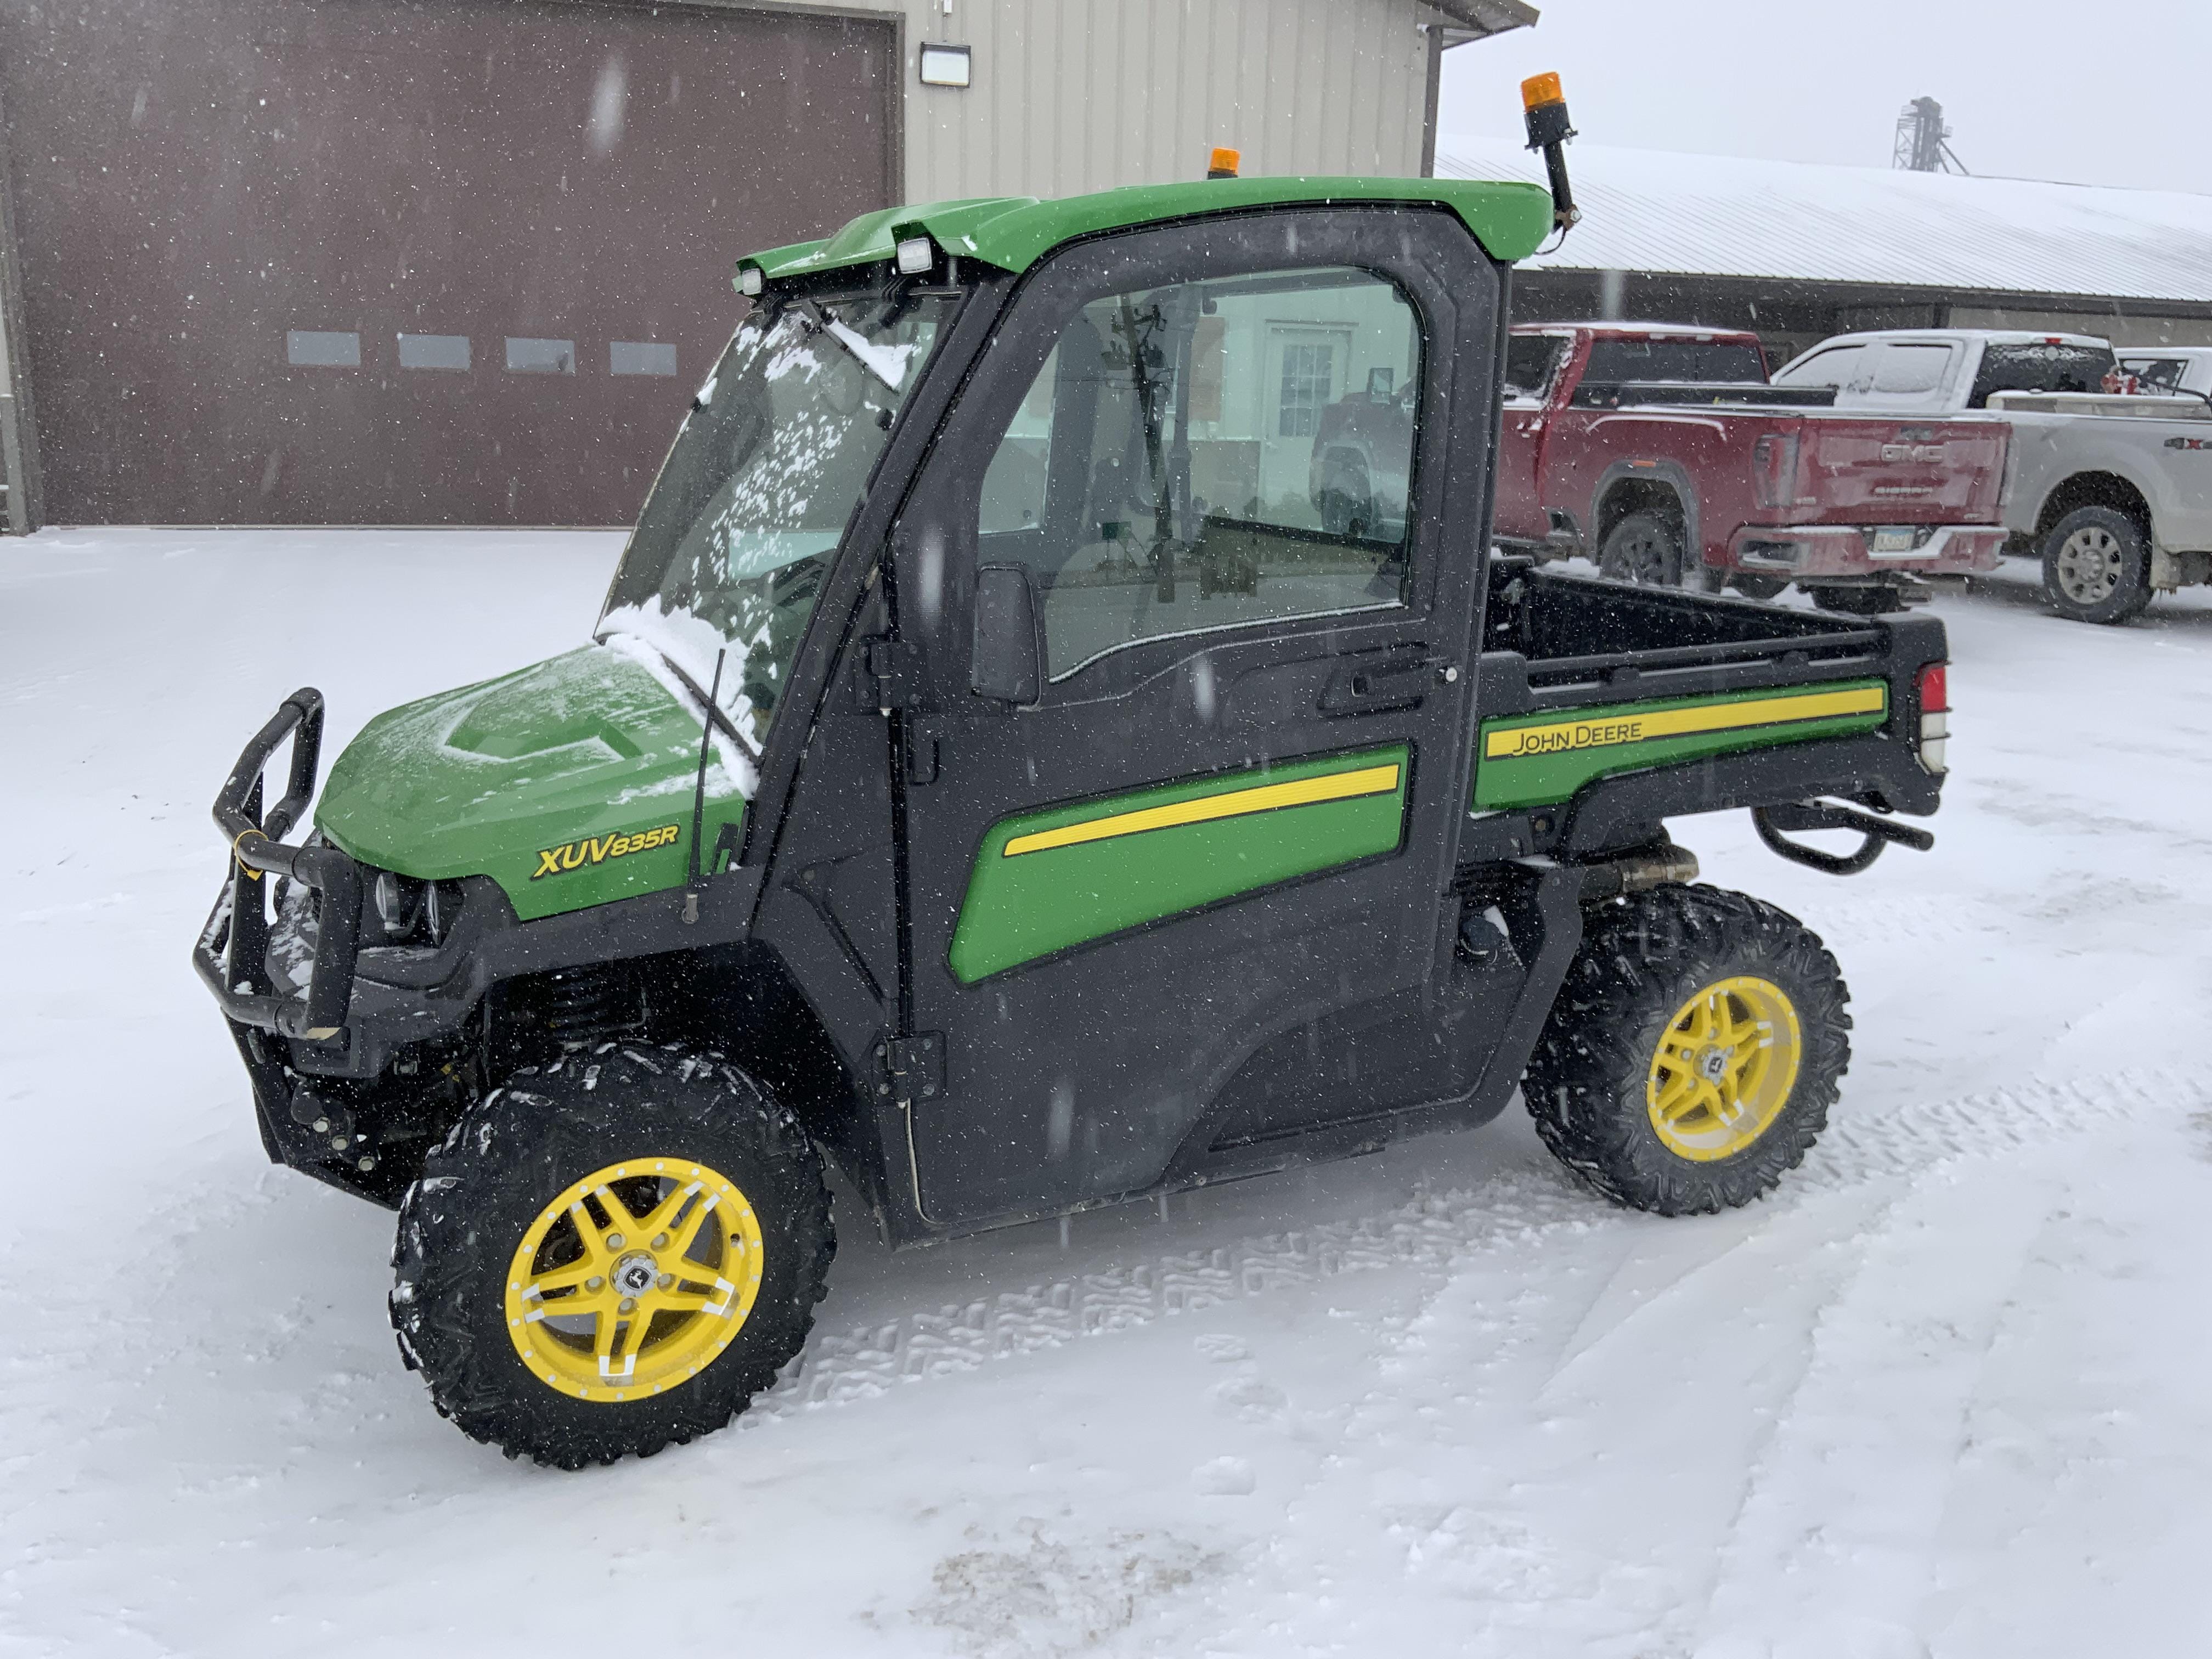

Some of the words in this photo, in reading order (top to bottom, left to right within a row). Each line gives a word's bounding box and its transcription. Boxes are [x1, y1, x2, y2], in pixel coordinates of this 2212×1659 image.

[1882, 444, 1944, 462] GMC
[1513, 731, 1569, 753] JOHN
[1576, 723, 1642, 744] DEERE
[532, 824, 679, 879] XUV835R
